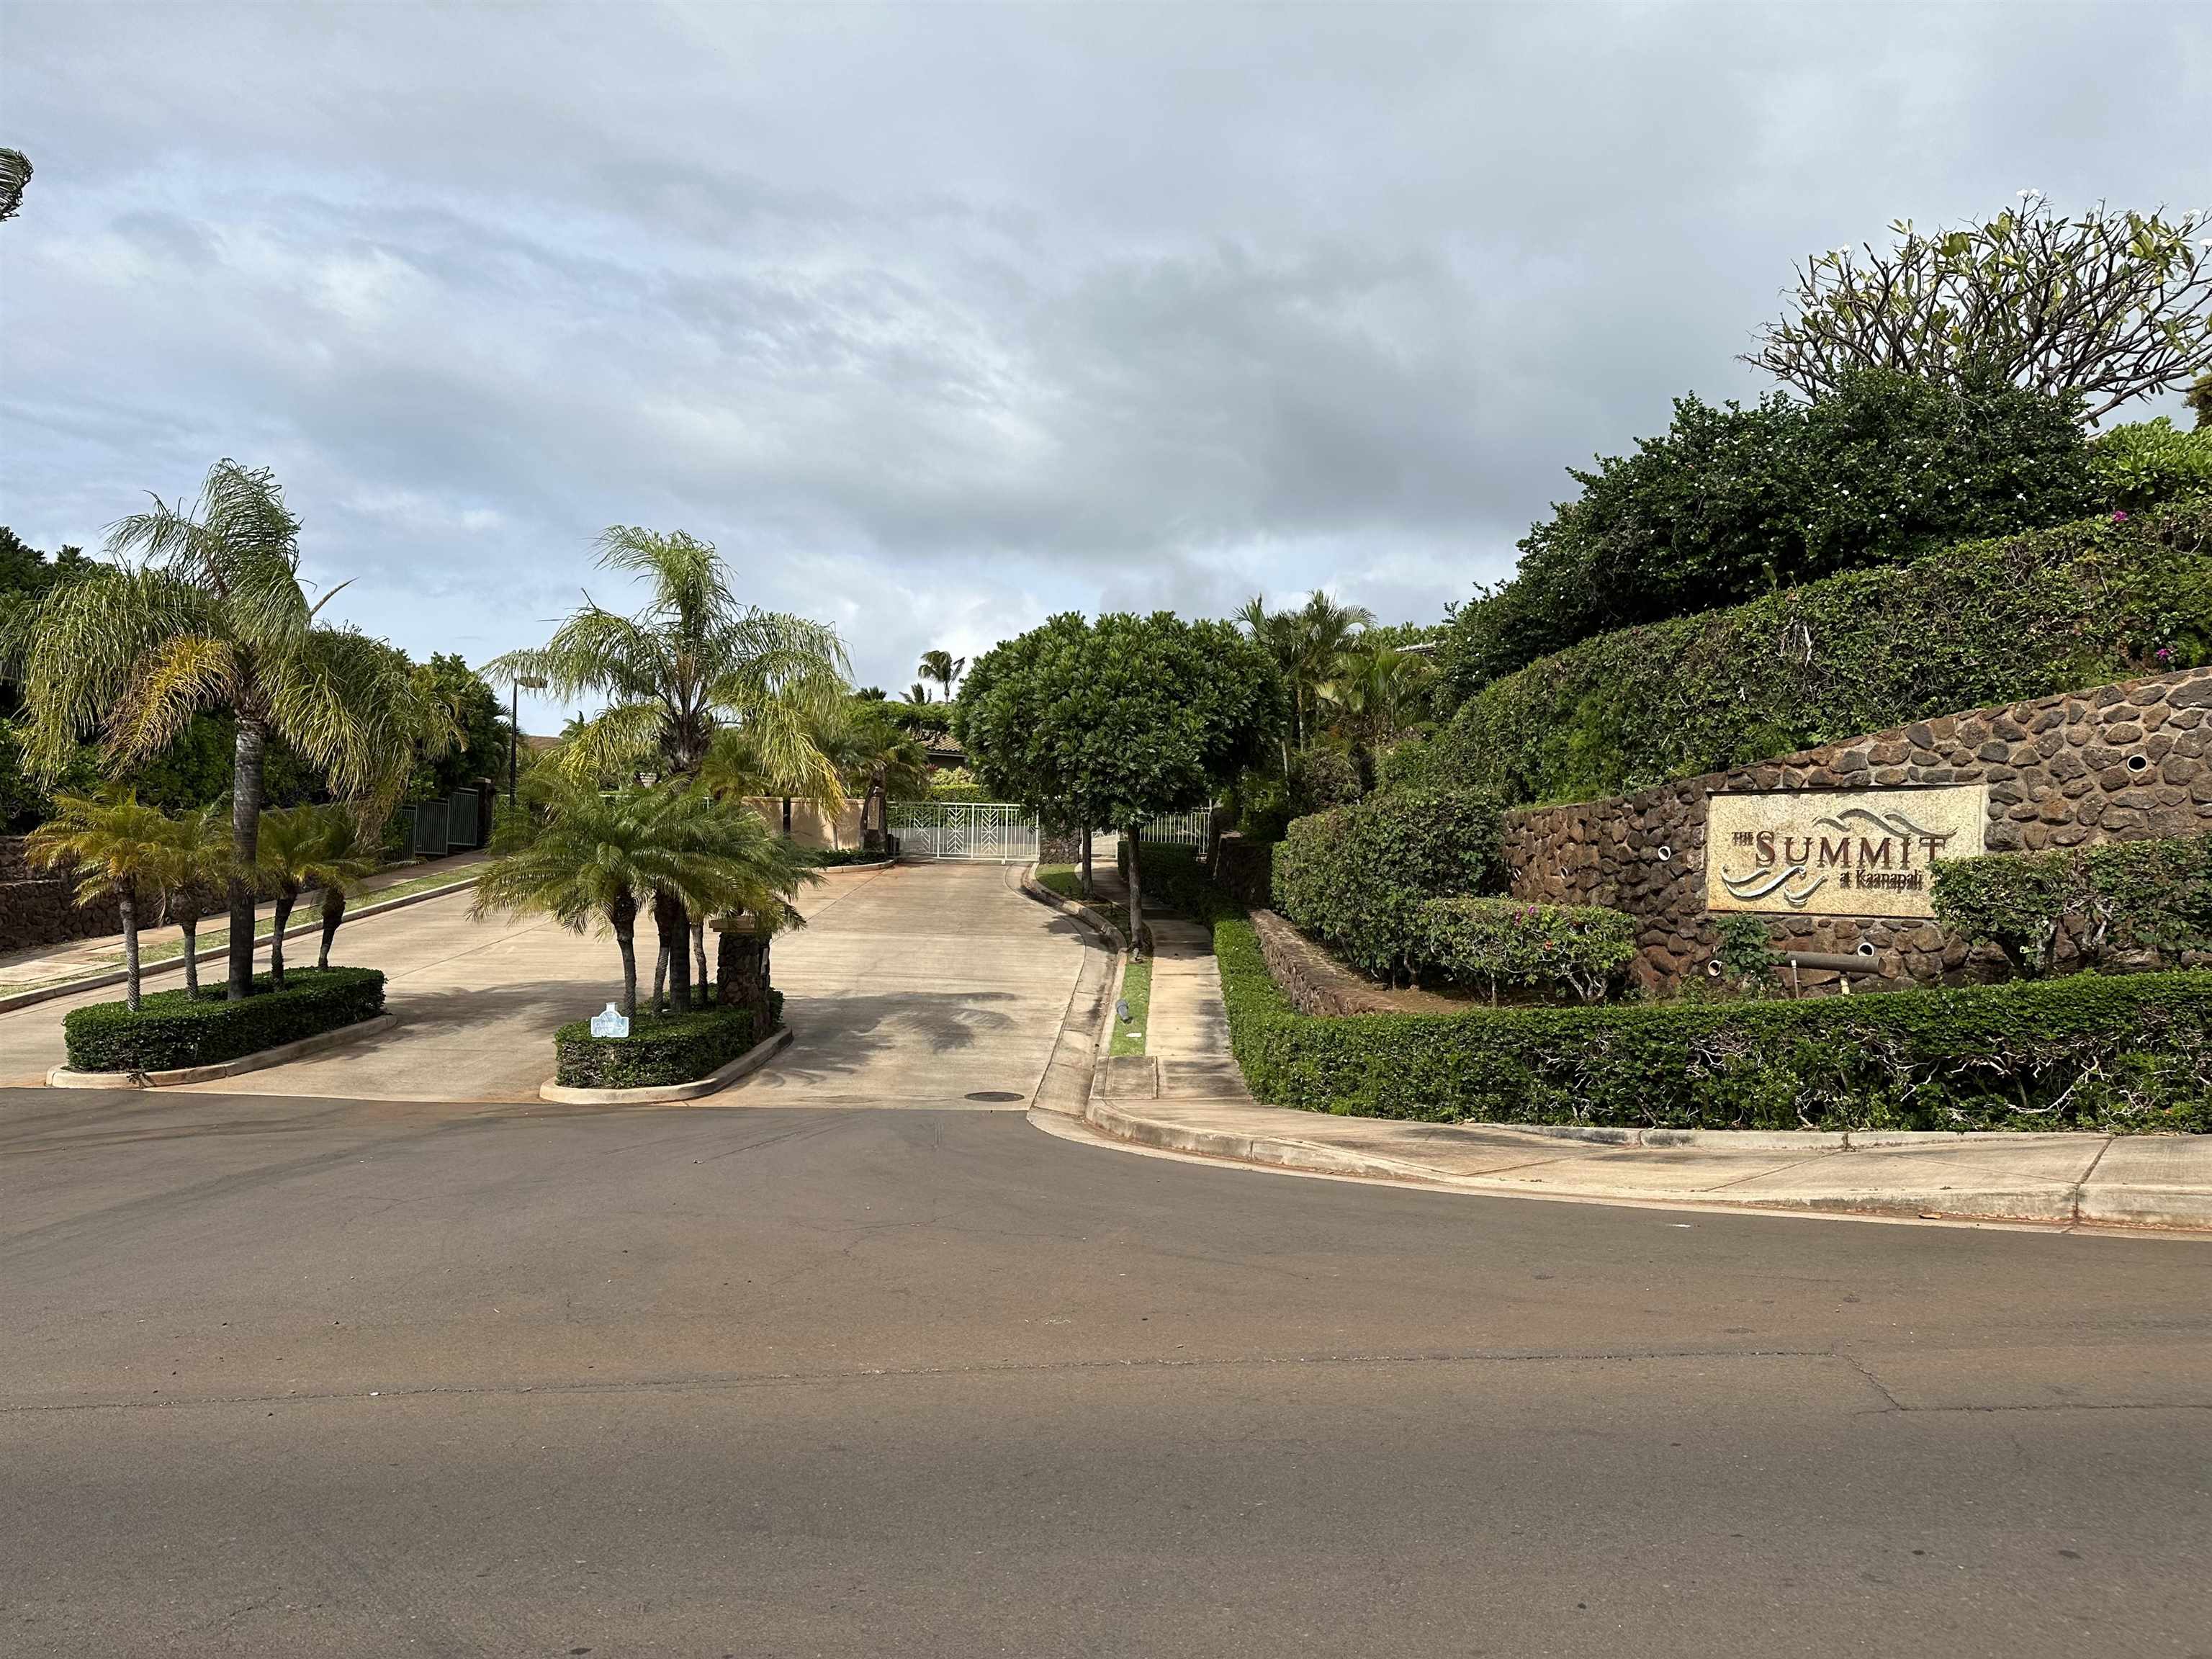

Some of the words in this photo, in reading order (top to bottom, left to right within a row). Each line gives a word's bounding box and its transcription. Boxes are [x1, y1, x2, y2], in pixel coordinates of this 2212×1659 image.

[1731, 831, 1754, 845] THE
[1755, 830, 1948, 868] SUMMIT
[1840, 871, 1851, 886] at
[1856, 868, 1923, 891] Kaanapali
